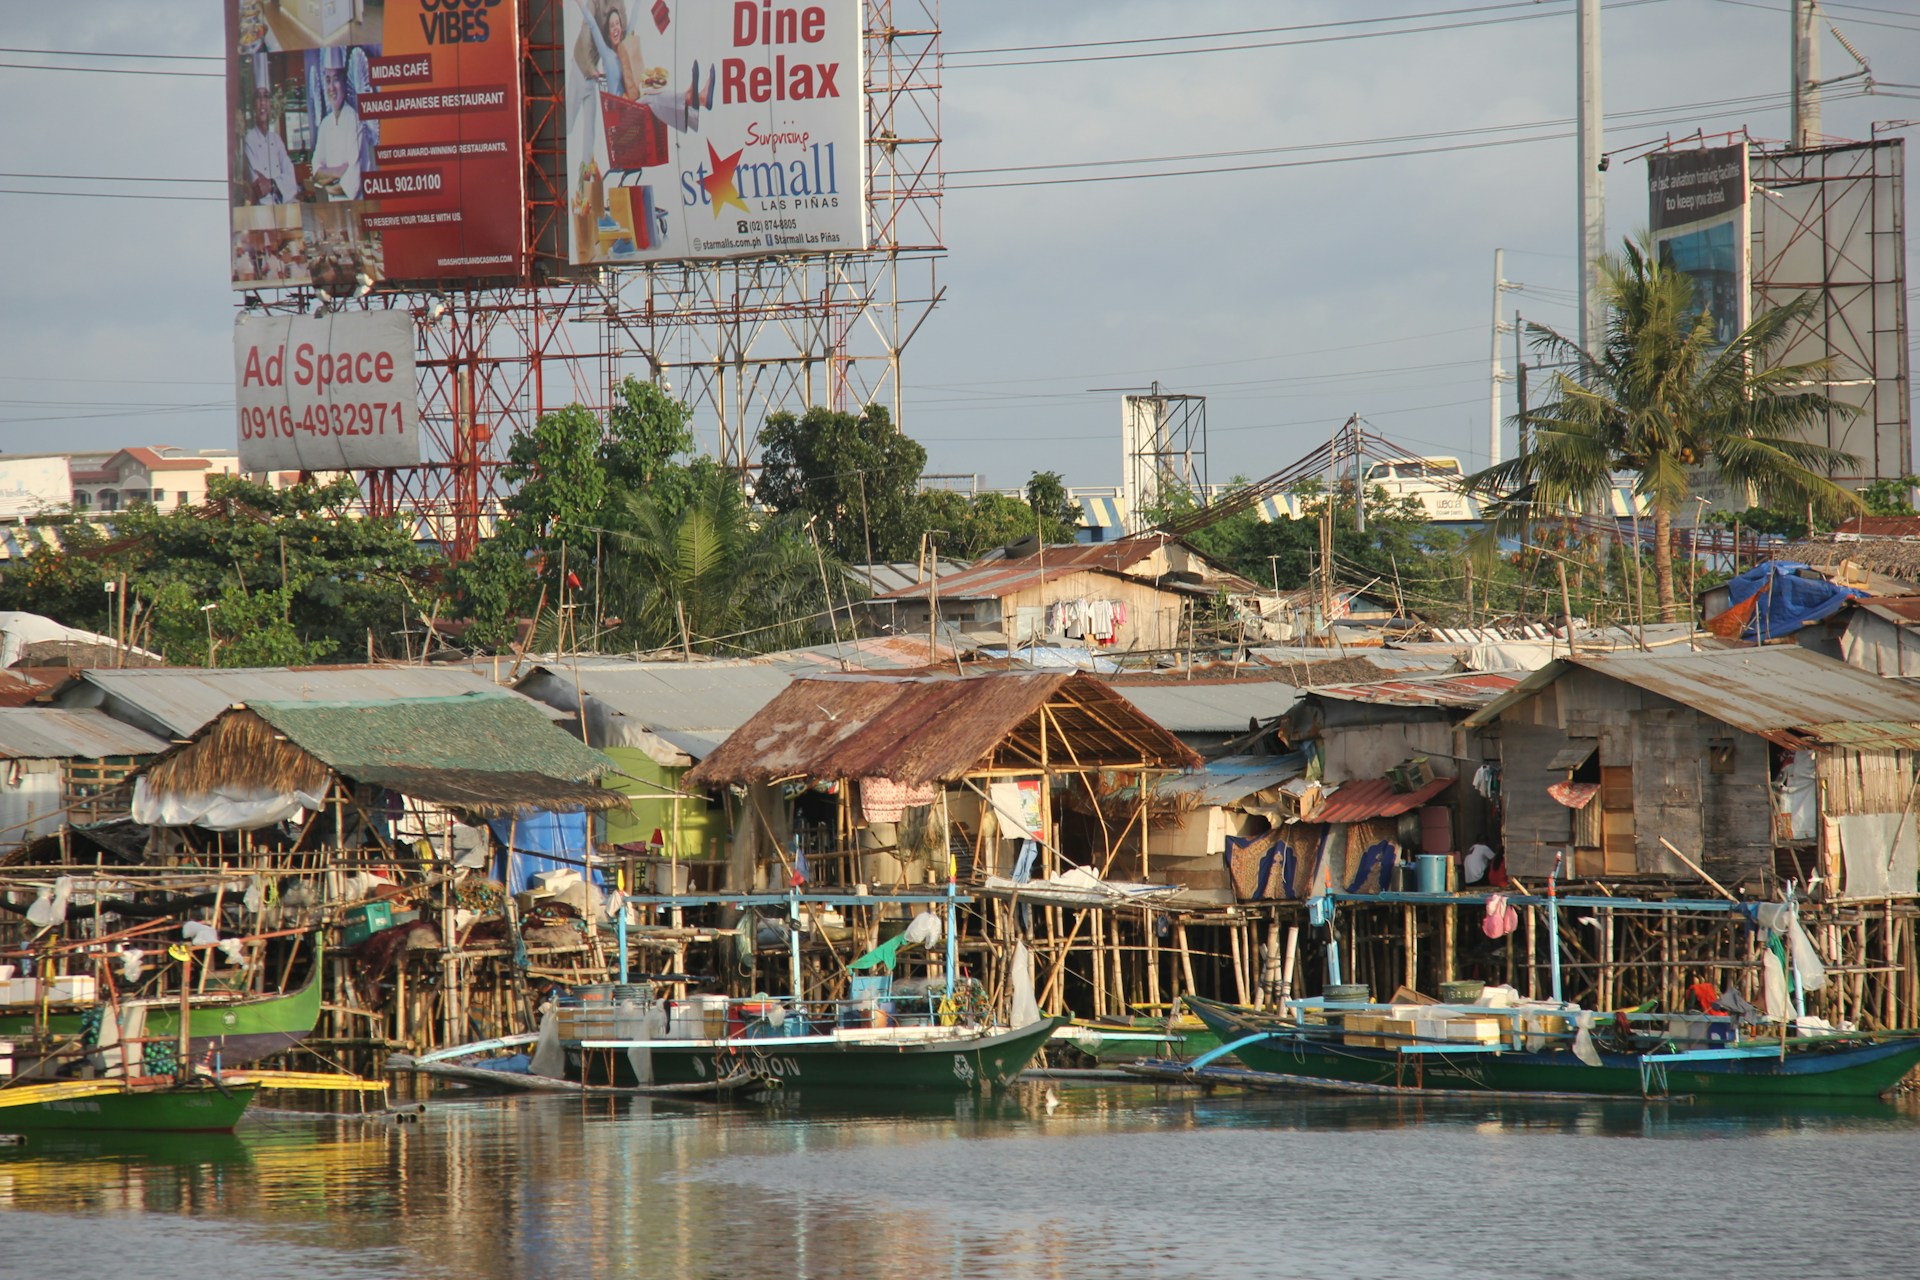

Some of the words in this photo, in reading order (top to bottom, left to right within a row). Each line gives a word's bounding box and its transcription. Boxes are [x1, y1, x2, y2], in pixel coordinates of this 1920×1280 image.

[418, 8, 490, 46] VIBES
[733, 0, 826, 47] Dine
[371, 64, 401, 79] MIDAS
[403, 59, 429, 77] CAFÉ
[722, 54, 840, 105] Relax
[361, 99, 393, 113] YANAGI
[394, 95, 440, 111] JAPANESE
[441, 91, 504, 108] RESTAURANT
[745, 120, 810, 153] Surprising
[377, 150, 392, 159] VISIT
[393, 148, 406, 158] OUR
[407, 145, 457, 156] AWARD-WINNING
[363, 178, 393, 194] CALL
[394, 174, 441, 192] 902.0100
[761, 200, 787, 211] LAS
[794, 196, 839, 210] PIÑAS
[373, 216, 400, 227] RESERVE
[400, 215, 417, 225] YOUR
[417, 214, 436, 223] TABLE
[435, 213, 452, 222] WITH
[749, 220, 763, 233] (02)
[774, 233, 804, 245] Starmall
[805, 233, 819, 243] Las
[243, 344, 285, 387] Ad
[294, 343, 394, 396] Space
[240, 401, 404, 440] 0916-4932971
